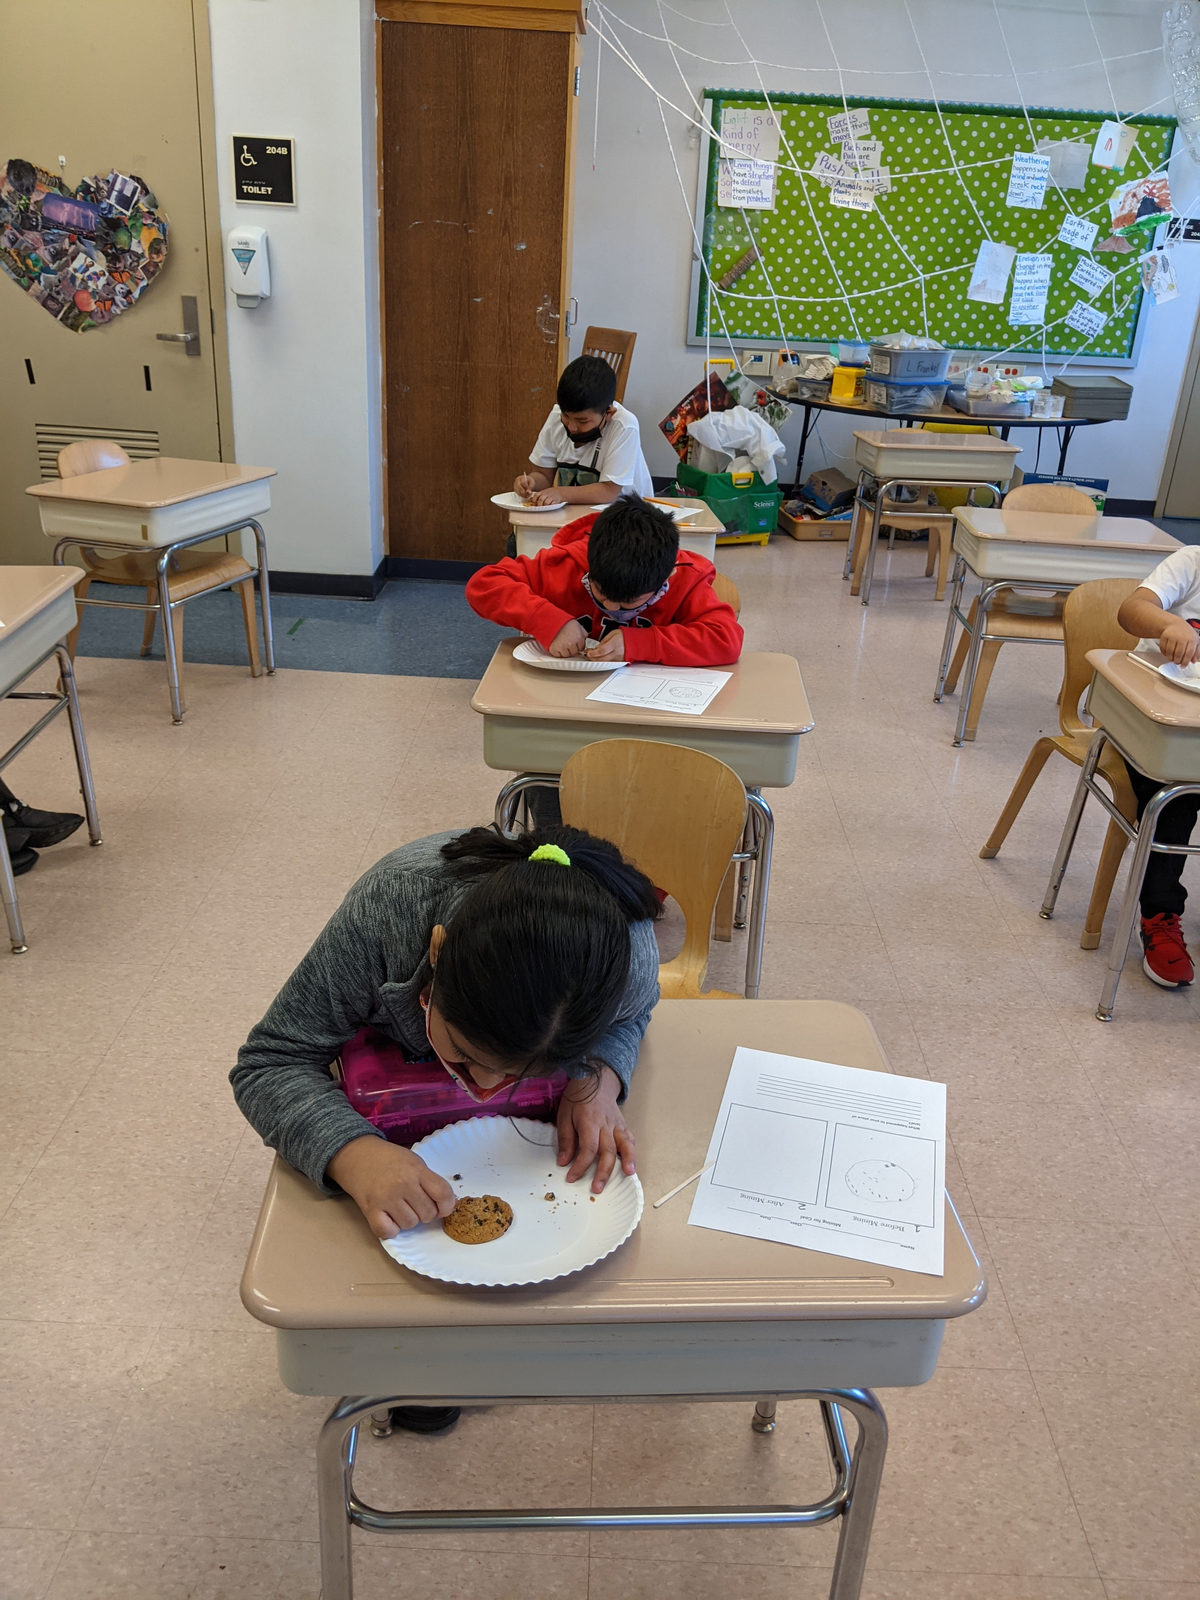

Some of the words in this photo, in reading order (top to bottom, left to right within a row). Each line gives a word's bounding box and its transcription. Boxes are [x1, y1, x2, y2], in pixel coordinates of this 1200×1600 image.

[753, 116, 763, 126] is
[766, 116, 774, 126] a
[746, 127, 759, 139] of
[265, 146, 288, 155] 204B
[723, 142, 760, 158] nergy
[862, 143, 876, 152] and
[819, 154, 846, 177] Push
[1014, 155, 1050, 168] Weathering
[241, 185, 273, 195] TOILET
[834, 180, 862, 191] Animals
[739, 1192, 765, 1204] Mining
[767, 1199, 785, 1207] After
[852, 1215, 879, 1227] Mining
[880, 1221, 905, 1232] Before
